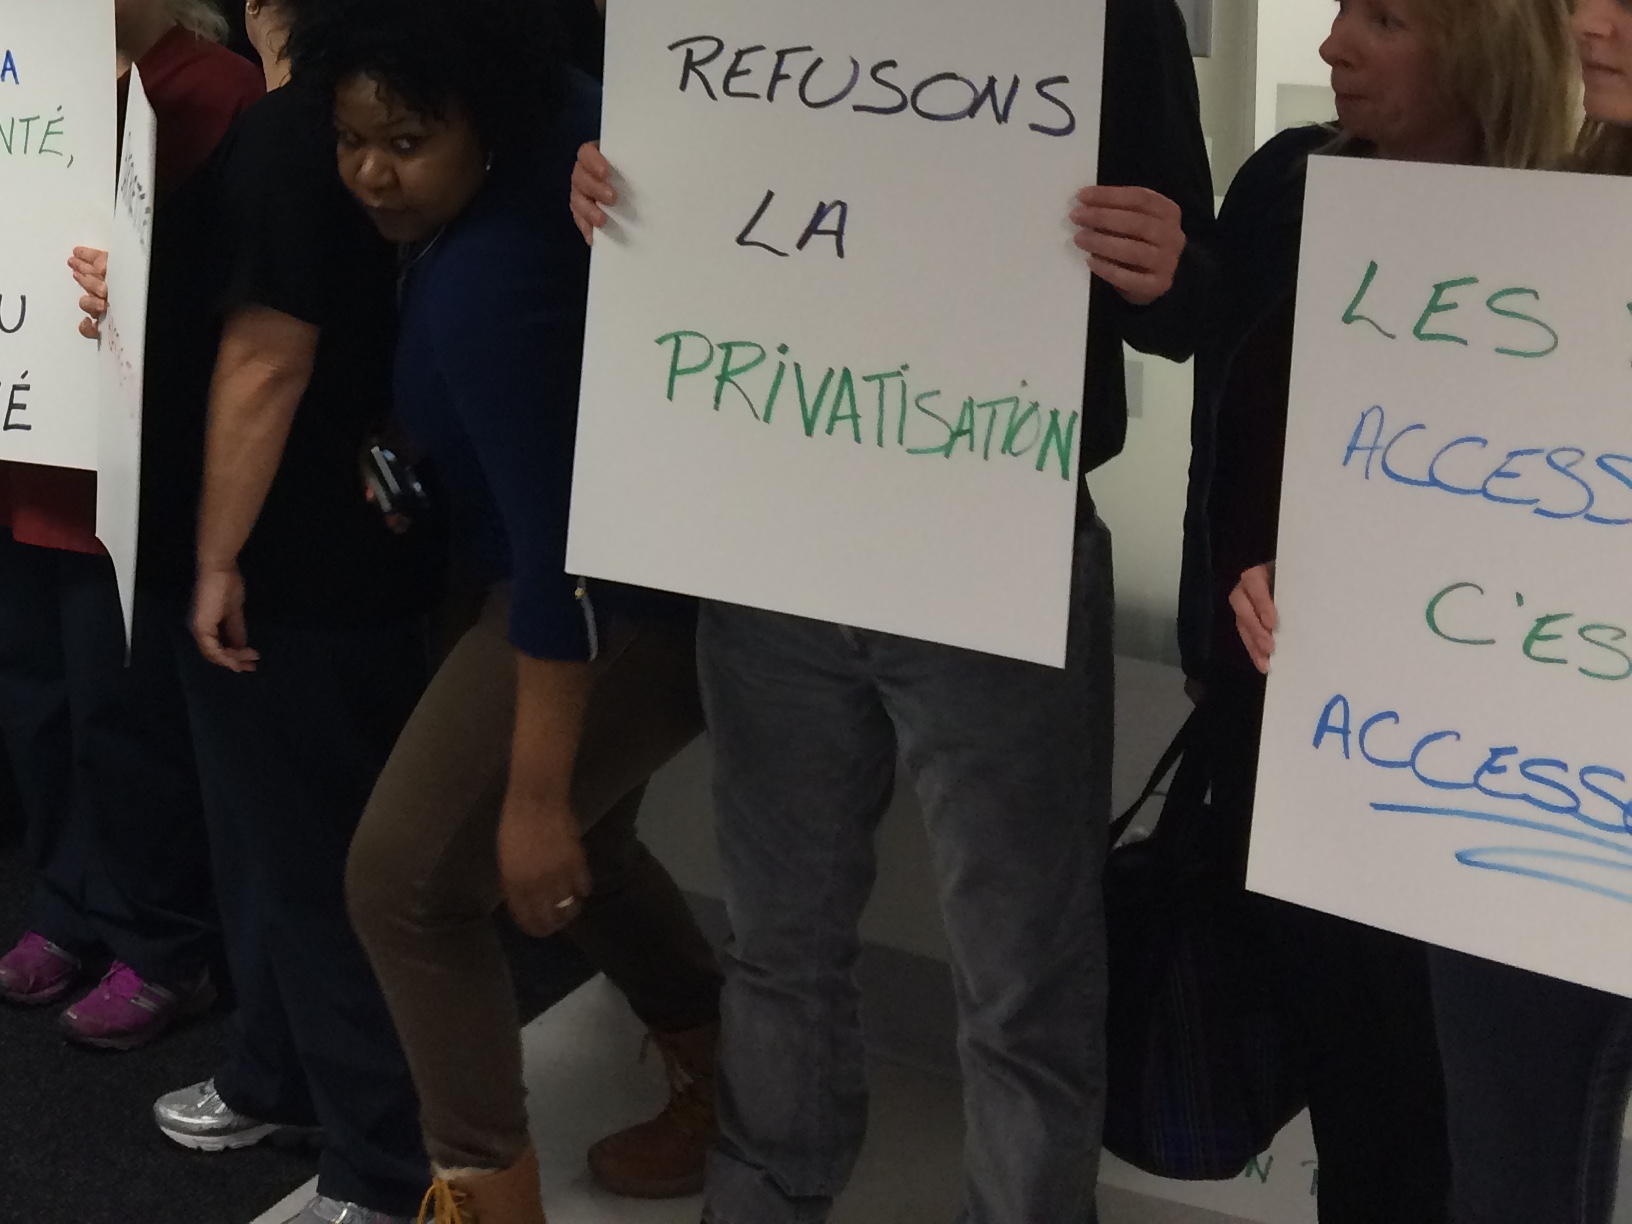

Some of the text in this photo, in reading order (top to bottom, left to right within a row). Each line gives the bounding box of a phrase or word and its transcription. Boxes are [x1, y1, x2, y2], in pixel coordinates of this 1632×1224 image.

[668, 35, 1076, 137] REFUSONS
[735, 189, 848, 259] LA
[1341, 260, 1559, 359] LES
[654, 329, 1079, 481] PRIVATISATION
[1312, 694, 1632, 836] ACCESS
